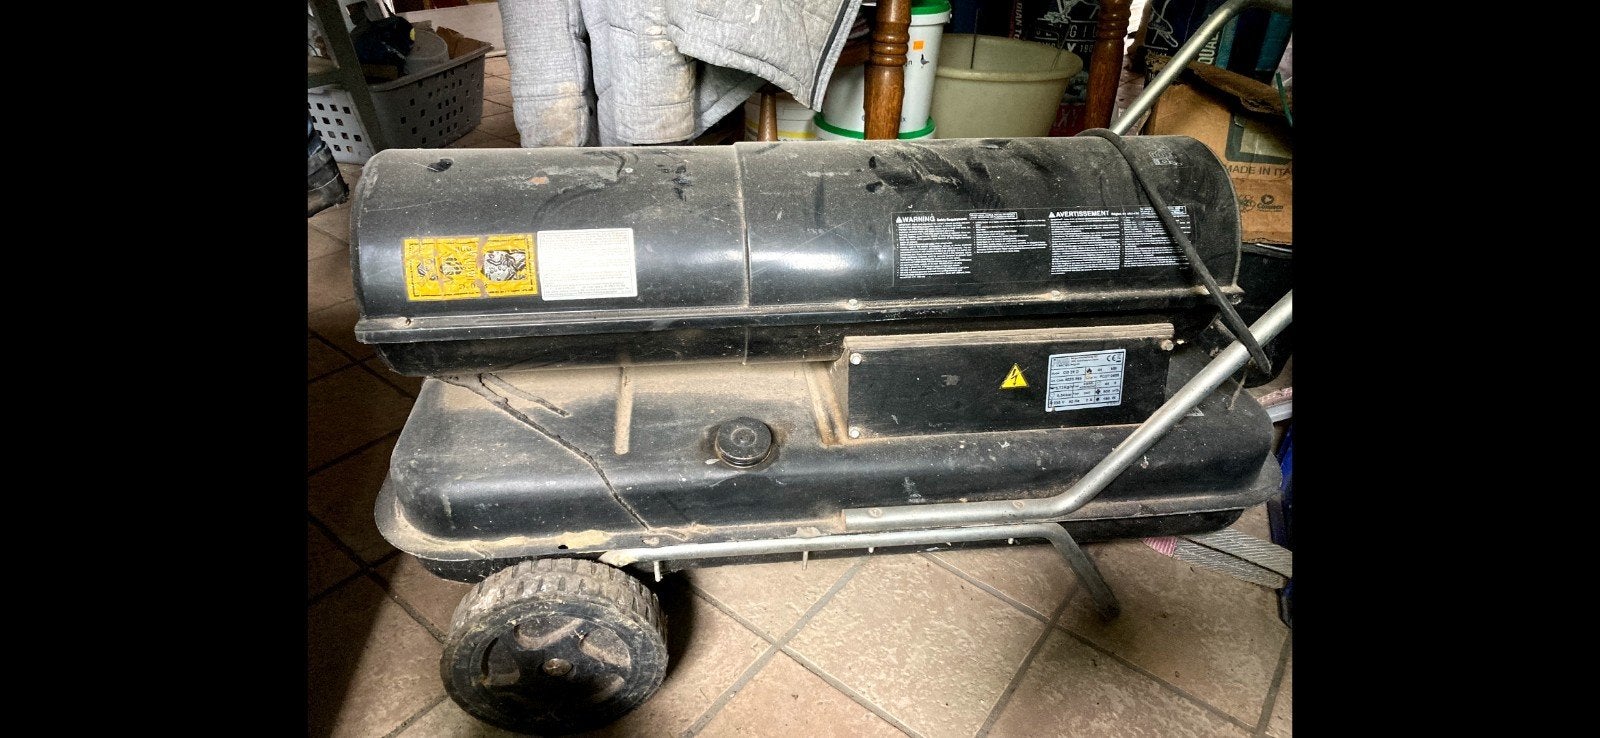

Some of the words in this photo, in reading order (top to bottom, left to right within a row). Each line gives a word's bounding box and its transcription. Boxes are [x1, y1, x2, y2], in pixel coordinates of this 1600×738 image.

[1227, 164, 1256, 175] MADE
[1259, 165, 1271, 175] IN
[1056, 210, 1110, 218] AVERTISSEMENT
[901, 215, 935, 223] WARNING
